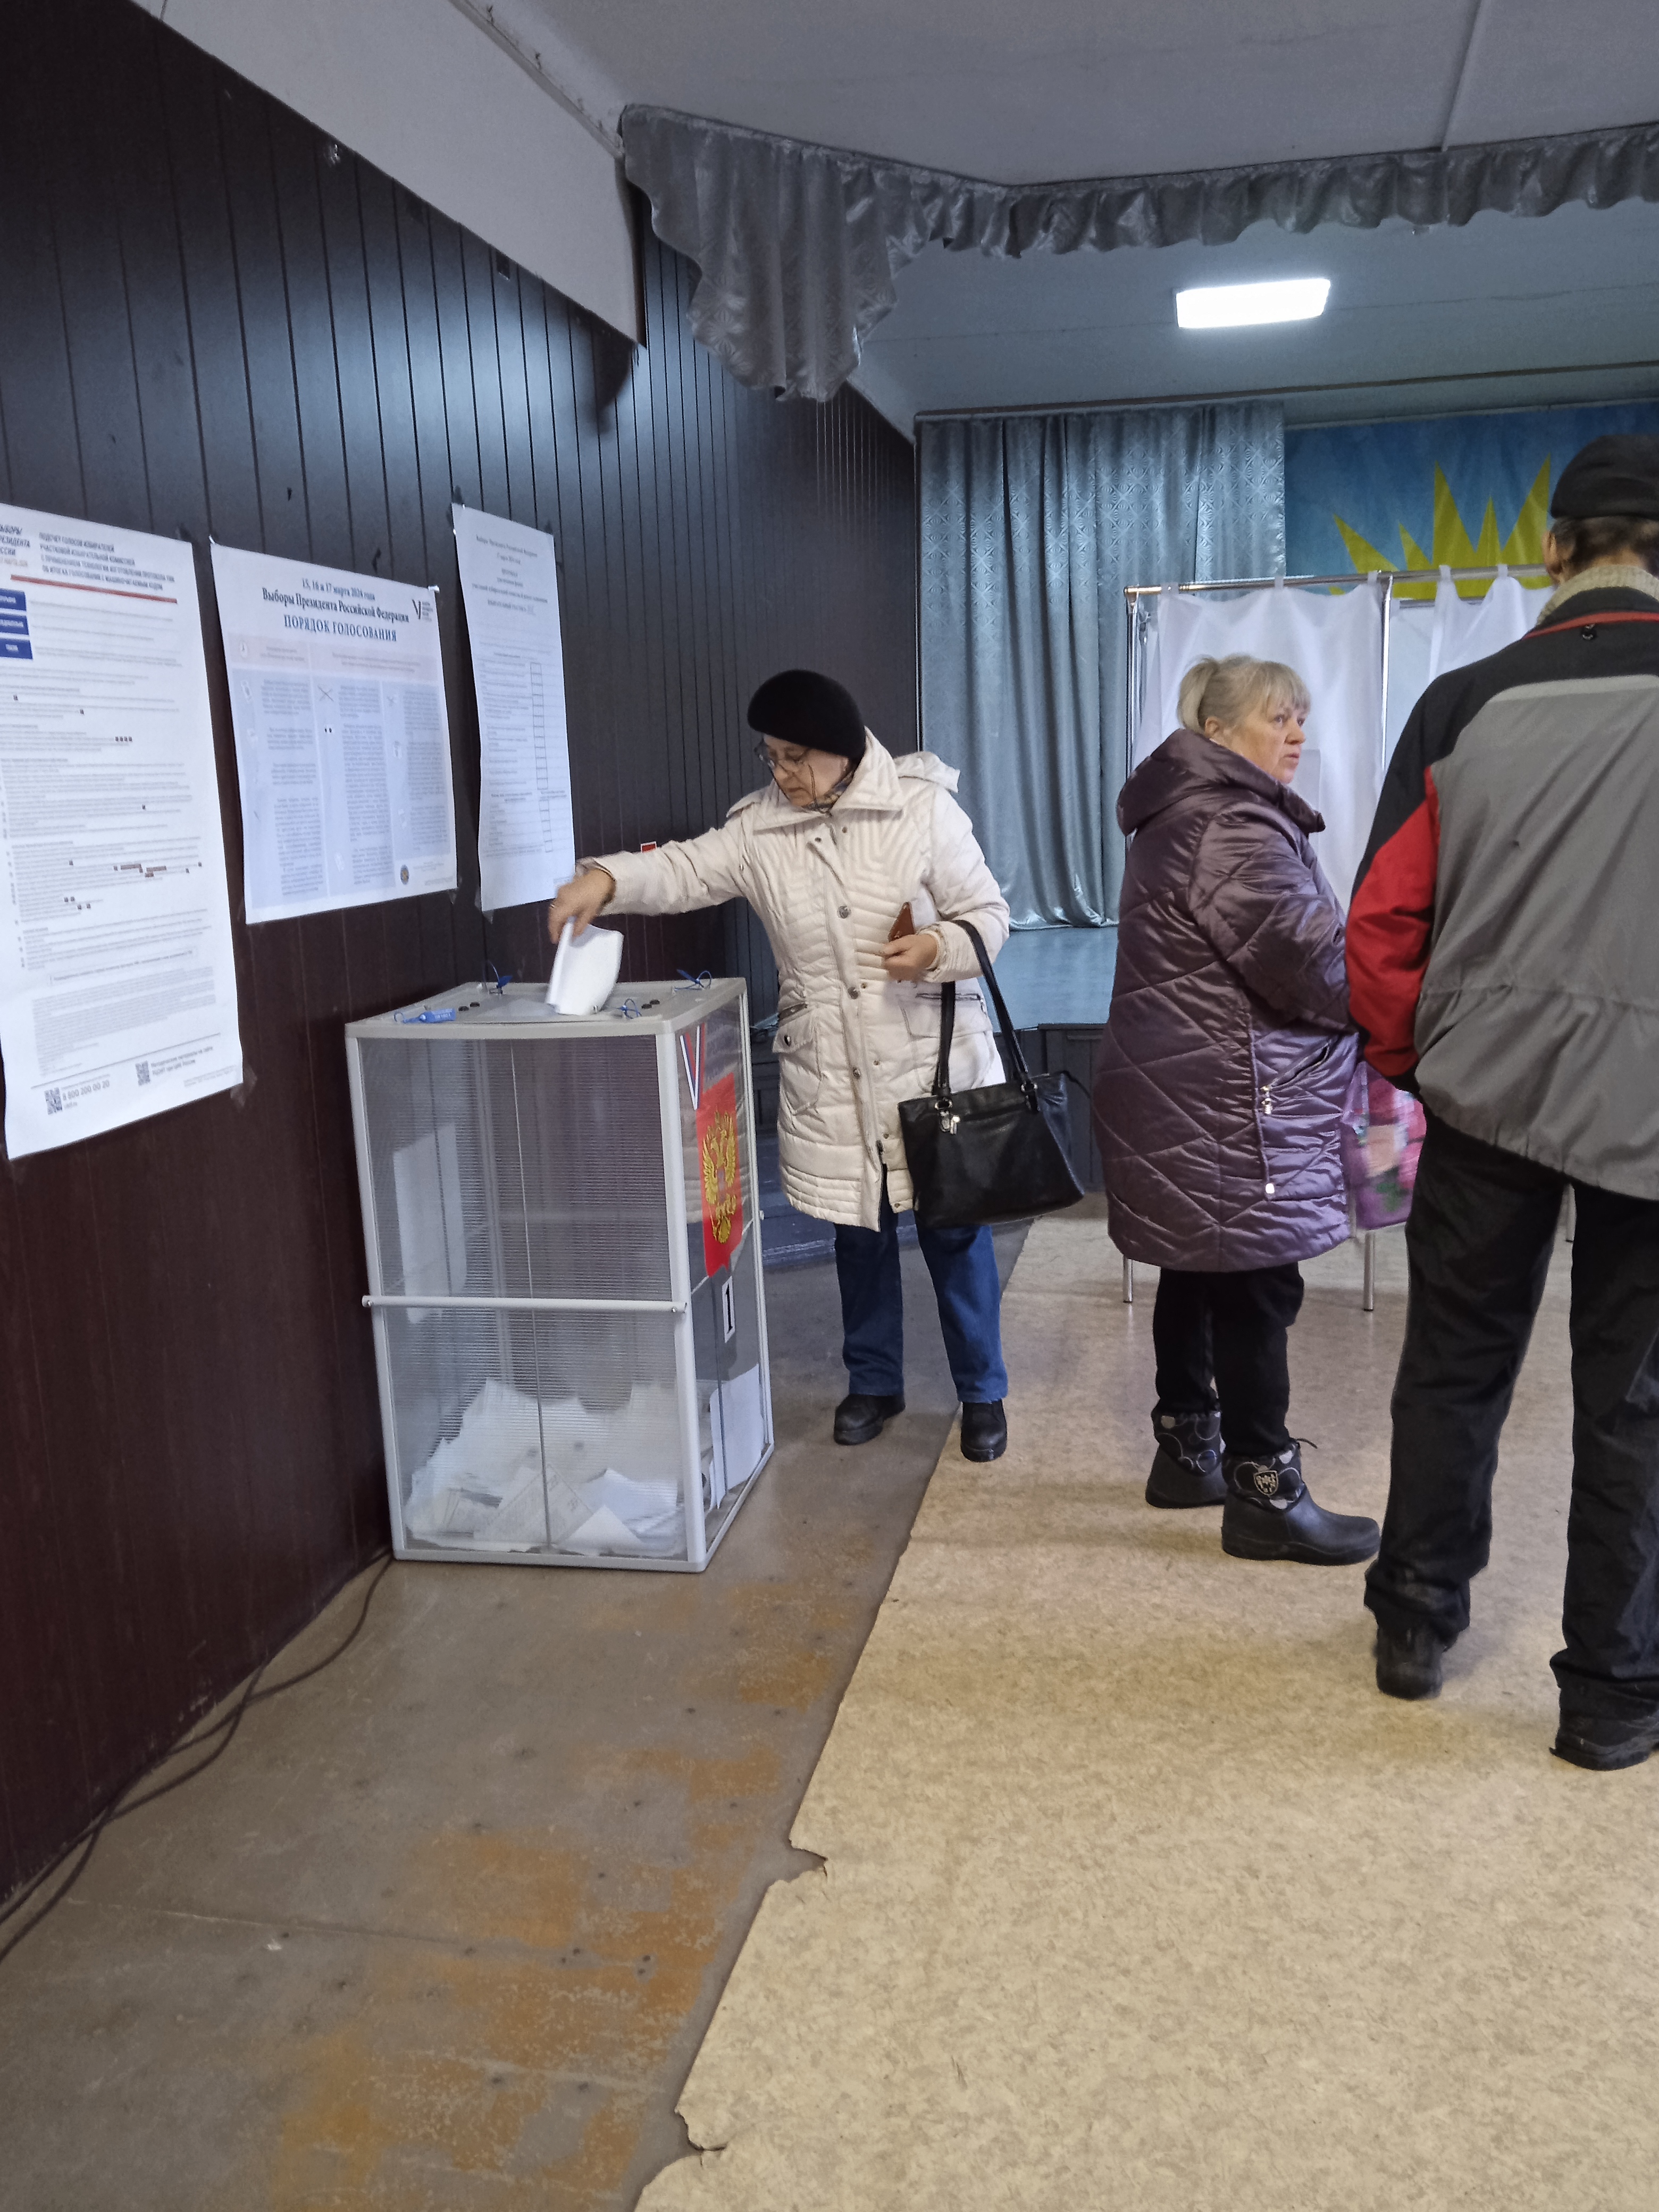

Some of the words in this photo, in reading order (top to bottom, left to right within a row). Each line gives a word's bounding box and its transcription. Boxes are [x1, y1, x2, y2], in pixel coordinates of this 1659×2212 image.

[0, 534, 31, 548] РЕЗИДЕНТА
[302, 578, 311, 590] 15,
[312, 580, 319, 591] 16
[326, 582, 332, 592] 17
[333, 586, 350, 597] марта
[262, 587, 295, 607] Выборы
[296, 593, 338, 611] Президента
[338, 600, 376, 617] Российской
[376, 607, 409, 623] Федерации
[284, 614, 330, 633] ПОРЯДОК
[332, 621, 397, 642] ГОЛОСОВАНИЯ
[68, 1089, 79, 1100] 800
